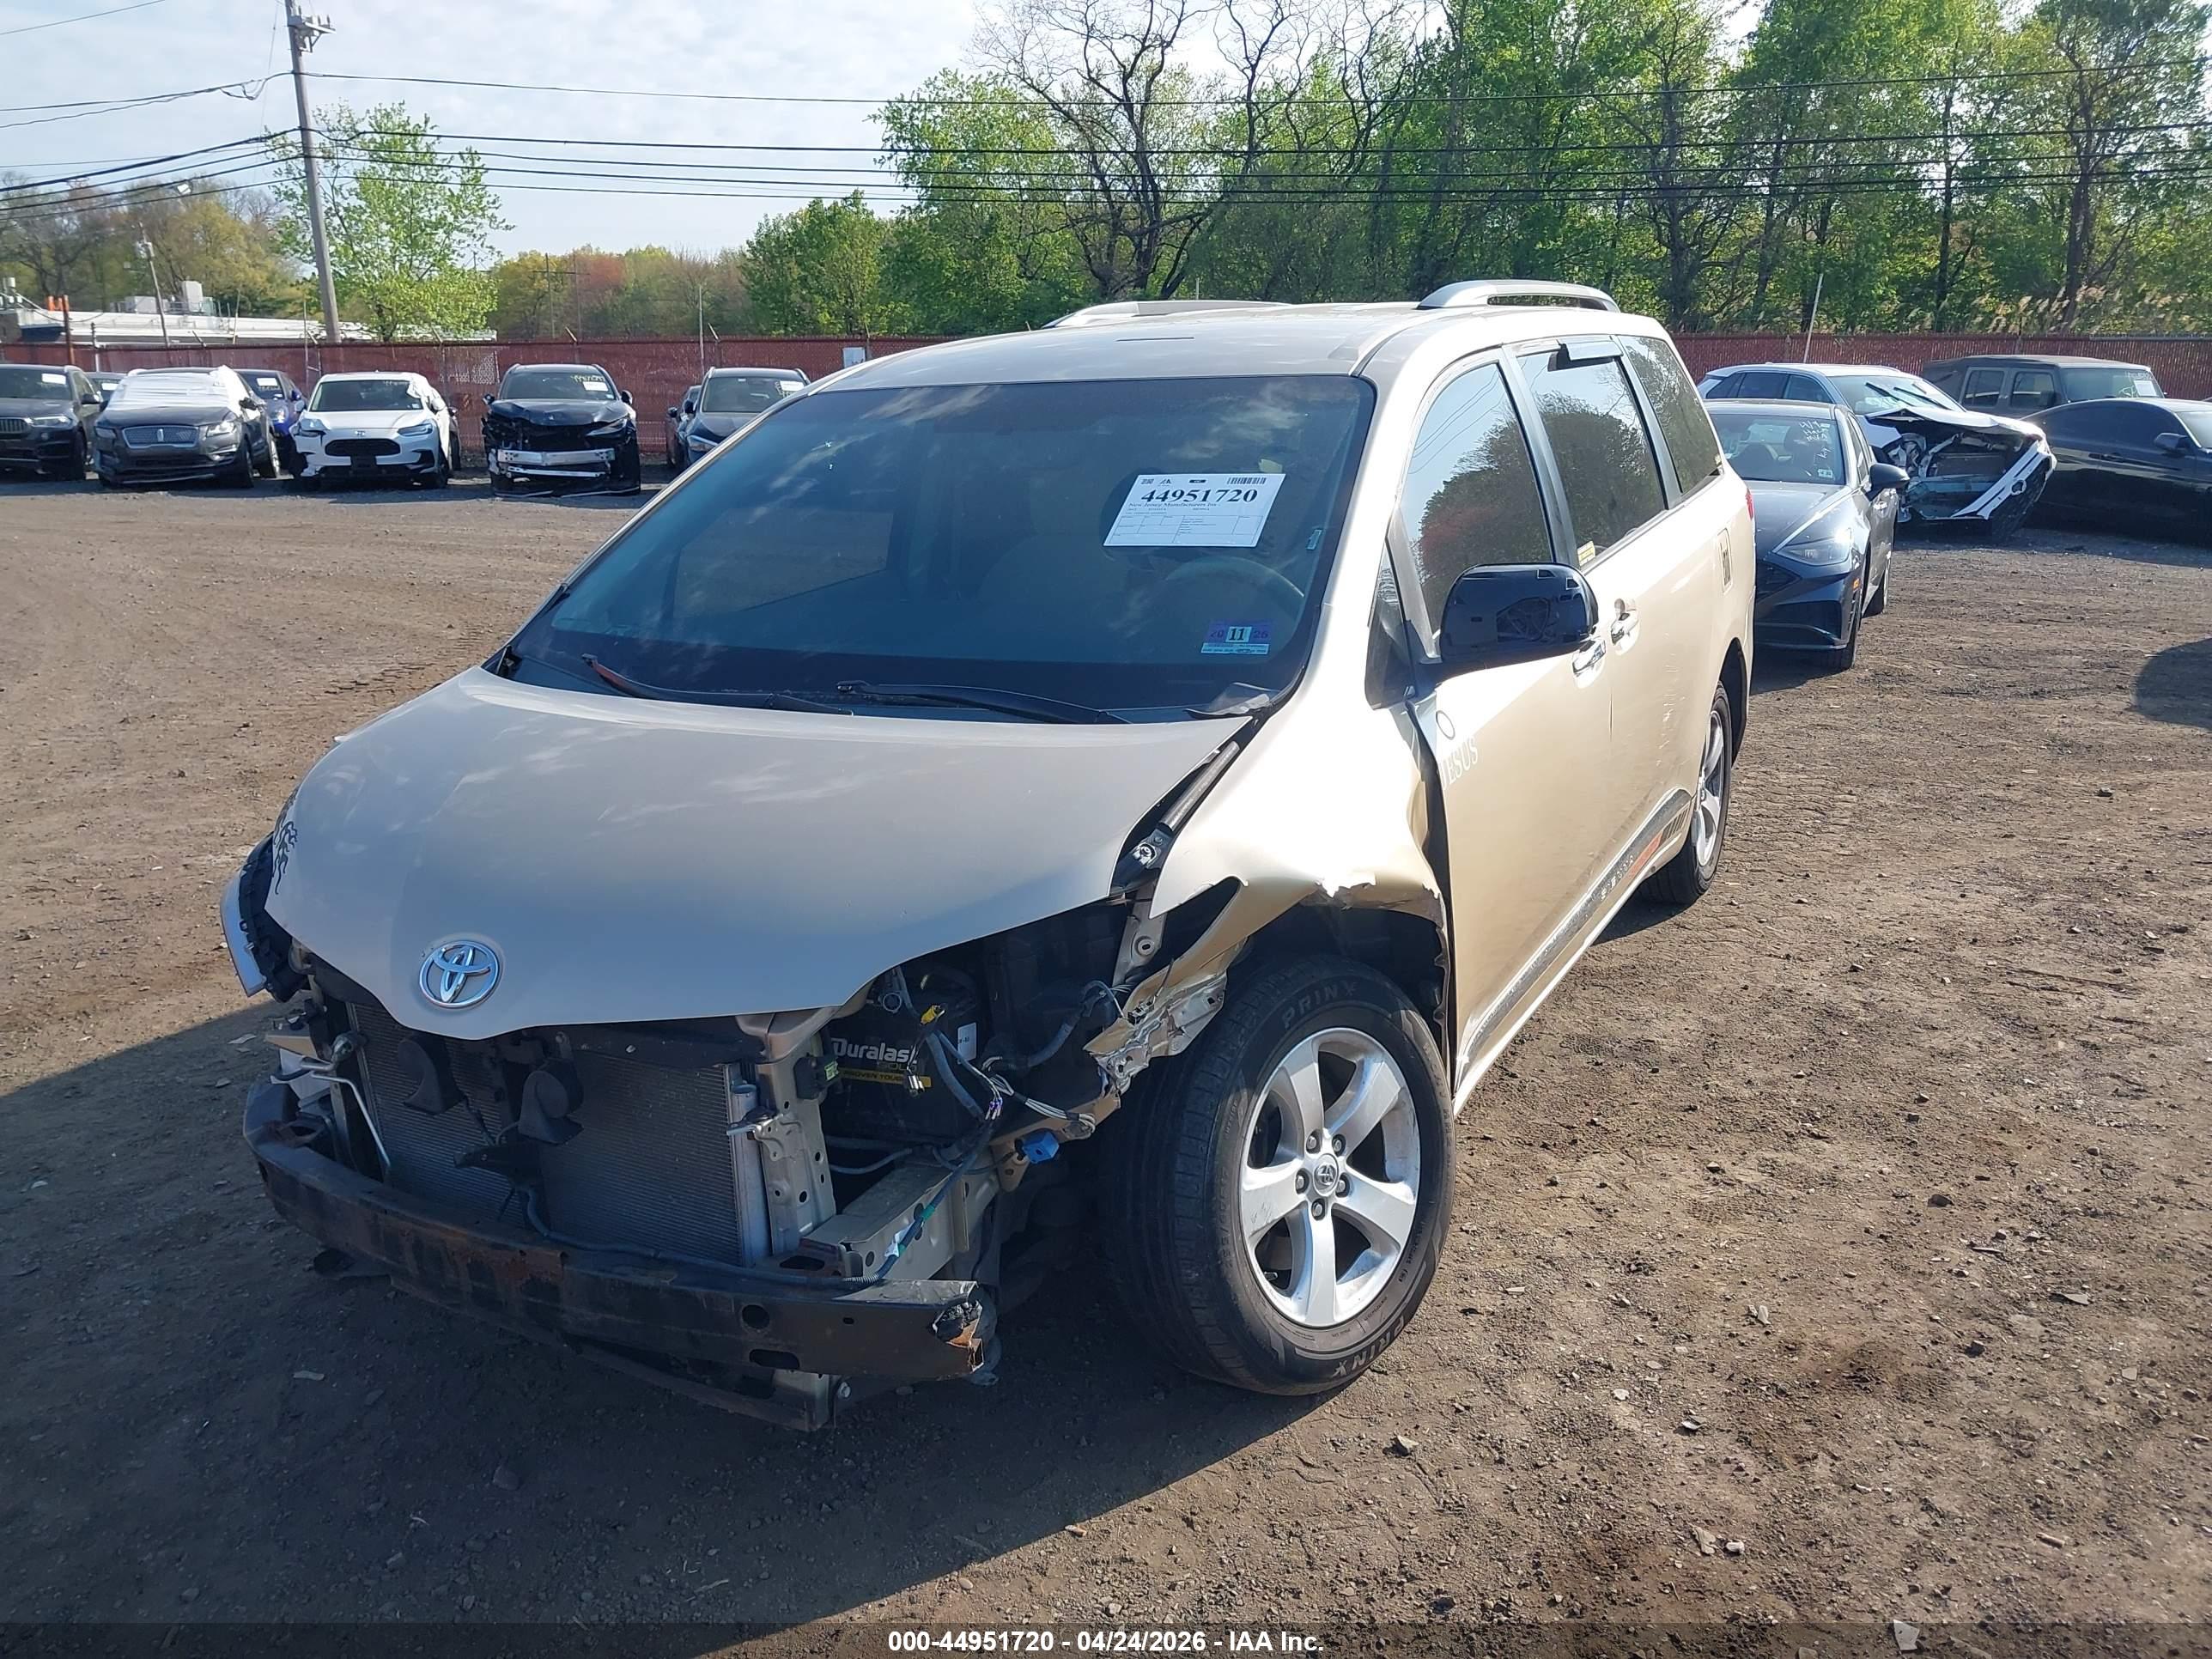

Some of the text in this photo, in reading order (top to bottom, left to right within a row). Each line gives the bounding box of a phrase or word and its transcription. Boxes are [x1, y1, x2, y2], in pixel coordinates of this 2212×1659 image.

[1141, 489, 1258, 502] 44951720
[1229, 628, 1245, 641] 11
[1439, 736, 1479, 790] JESUS
[1282, 981, 1358, 1029] PRINX
[1332, 1315, 1406, 1377] PRINX
